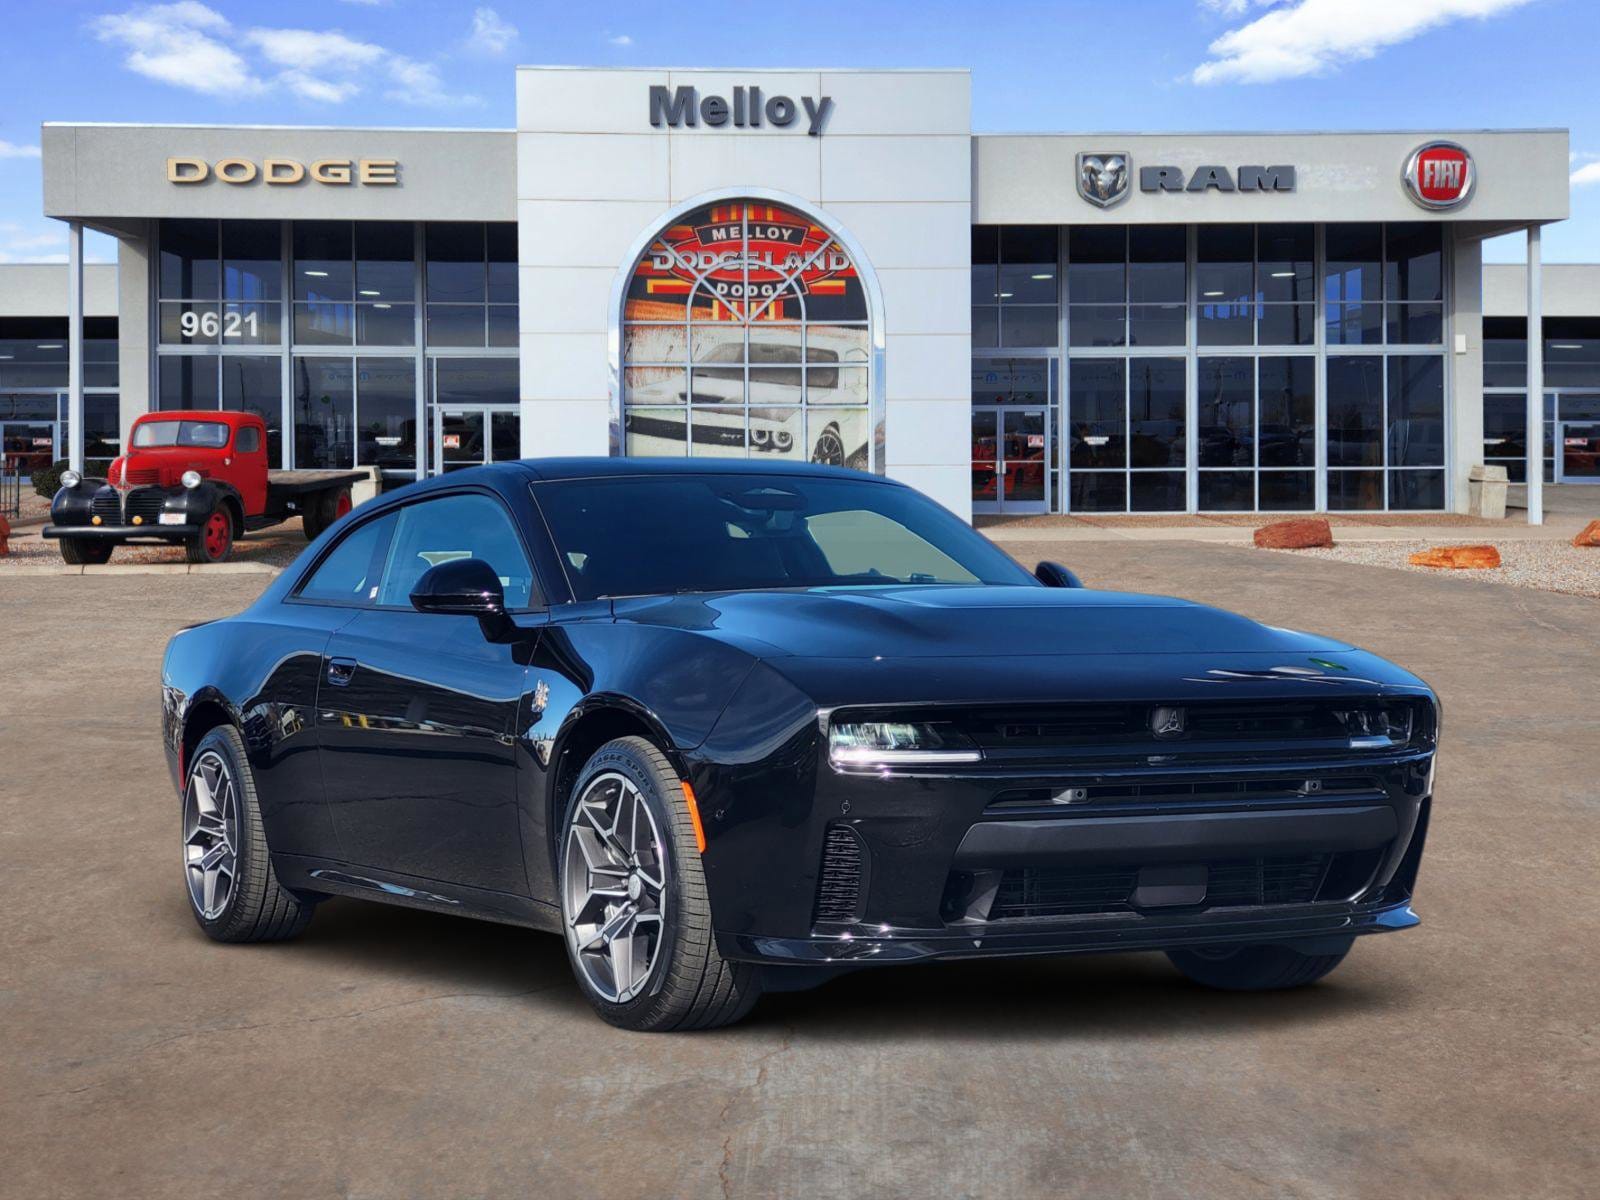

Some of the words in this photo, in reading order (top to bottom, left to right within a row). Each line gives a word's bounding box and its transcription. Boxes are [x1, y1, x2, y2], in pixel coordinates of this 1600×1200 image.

[649, 85, 831, 136] Melloy
[167, 157, 398, 184] DODGE
[1140, 165, 1295, 191] RAM
[1423, 160, 1463, 188] FIAT
[181, 311, 258, 337] 9621
[591, 753, 623, 768] EAGLE
